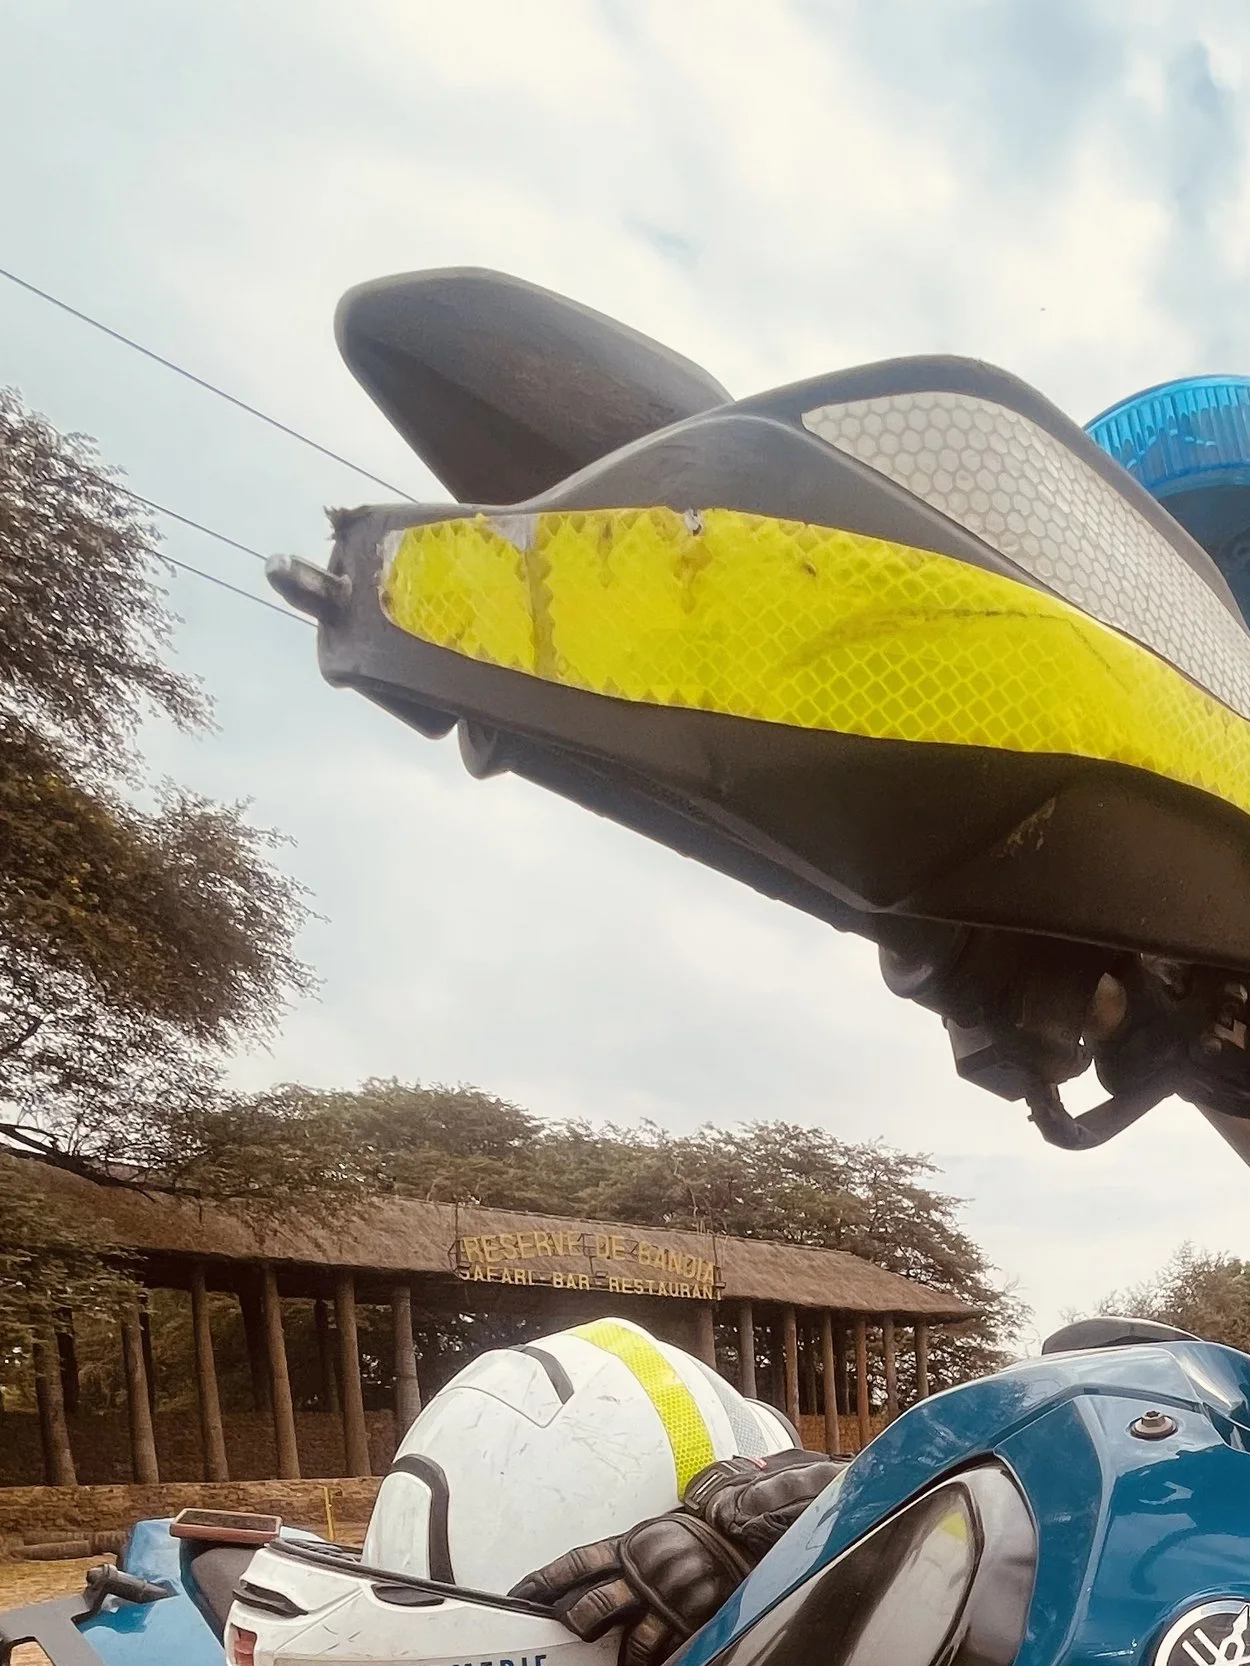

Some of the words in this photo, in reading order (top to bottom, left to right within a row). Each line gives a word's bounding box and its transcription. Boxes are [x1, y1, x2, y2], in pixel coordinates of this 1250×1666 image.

[462, 1231, 581, 1263] RESERVE
[596, 1232, 626, 1261] DE
[459, 1264, 535, 1286] SAFARI
[552, 1271, 590, 1291] BAR
